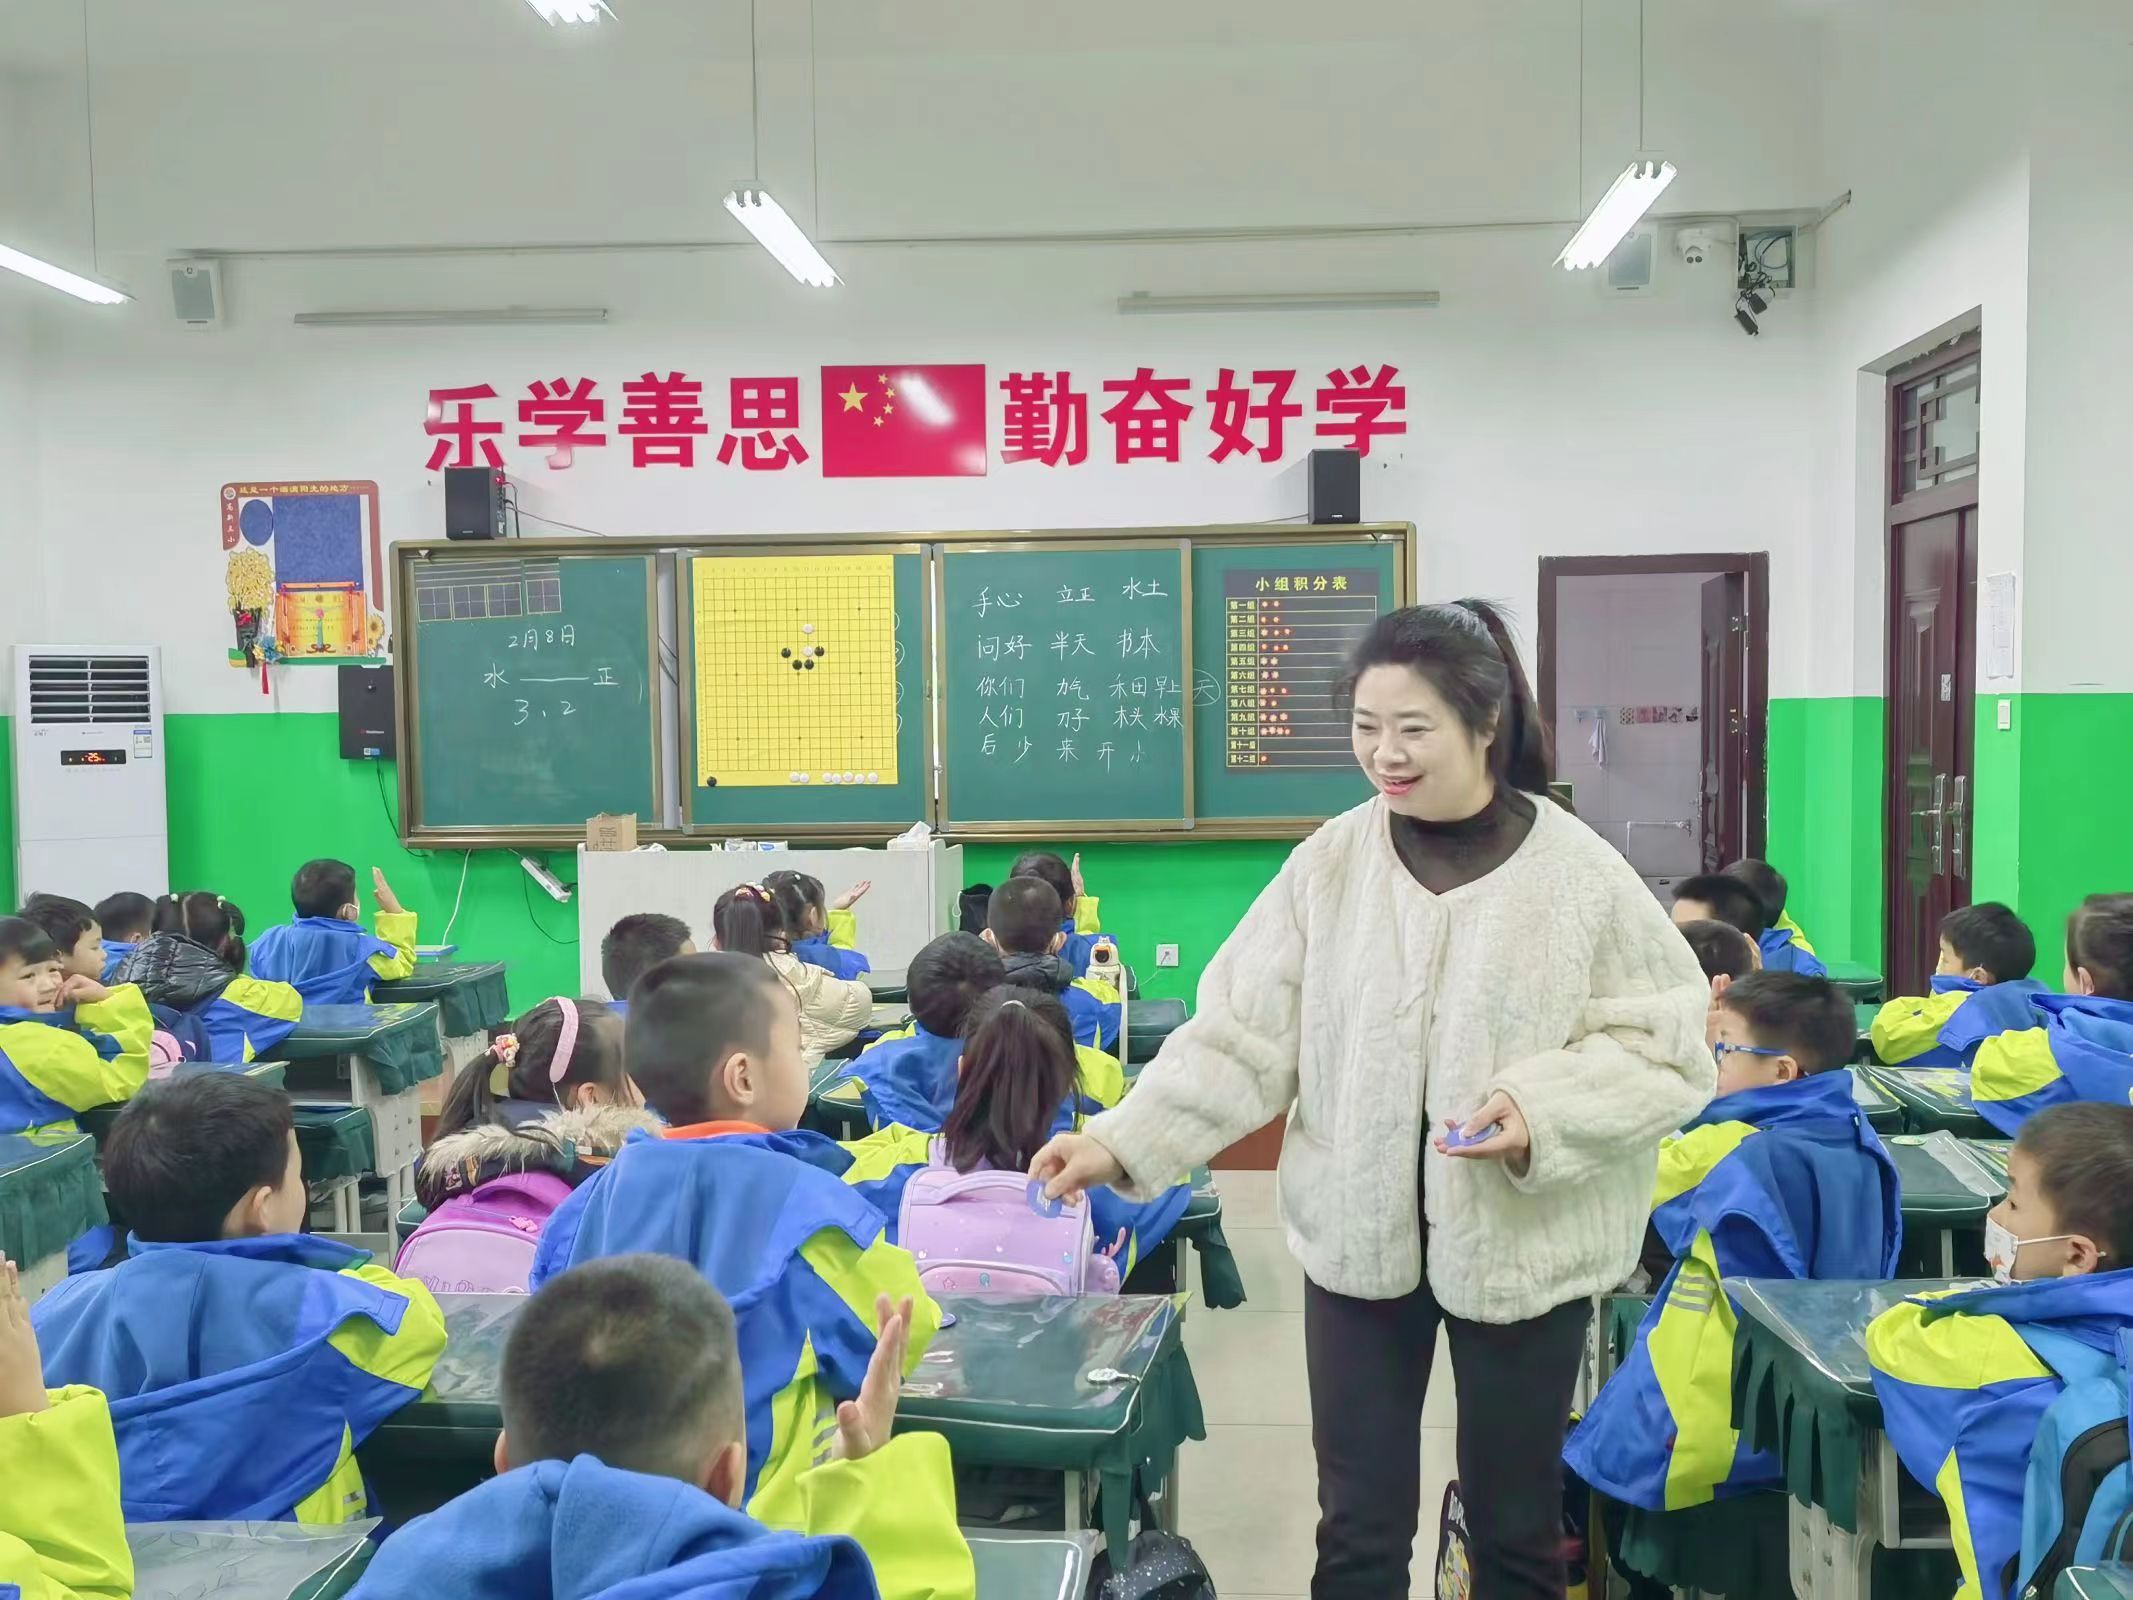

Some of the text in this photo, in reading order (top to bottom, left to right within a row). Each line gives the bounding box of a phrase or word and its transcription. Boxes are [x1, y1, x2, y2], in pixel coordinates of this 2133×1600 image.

[424, 364, 1407, 471] 乐学善思 勤奋好学
[1256, 576, 1347, 591] 小组积分表
[972, 577, 1168, 618] 手心 立正 水土
[1230, 601, 1256, 609] 第一组
[1230, 615, 1256, 624] 第二组
[1230, 629, 1256, 637] 第三组
[509, 625, 574, 651] 2月8日
[979, 628, 1160, 661] 问好 半天 书本
[1230, 643, 1256, 652] 第四组
[1230, 657, 1256, 666] 第五组
[1230, 671, 1256, 679] 第六组
[976, 676, 1024, 698] 你们
[1057, 677, 1089, 700] 力气
[1155, 676, 1182, 698] 早上
[1230, 685, 1256, 693] 第七组
[1230, 699, 1256, 707] 第八组
[979, 705, 1183, 732] 人们 刀子 木头 水果
[1230, 713, 1256, 721] 第九组
[1230, 727, 1256, 736] 第十组
[1015, 736, 1032, 762] 少
[1230, 740, 1256, 749] 第十一组
[1230, 754, 1256, 763] 第十二组
